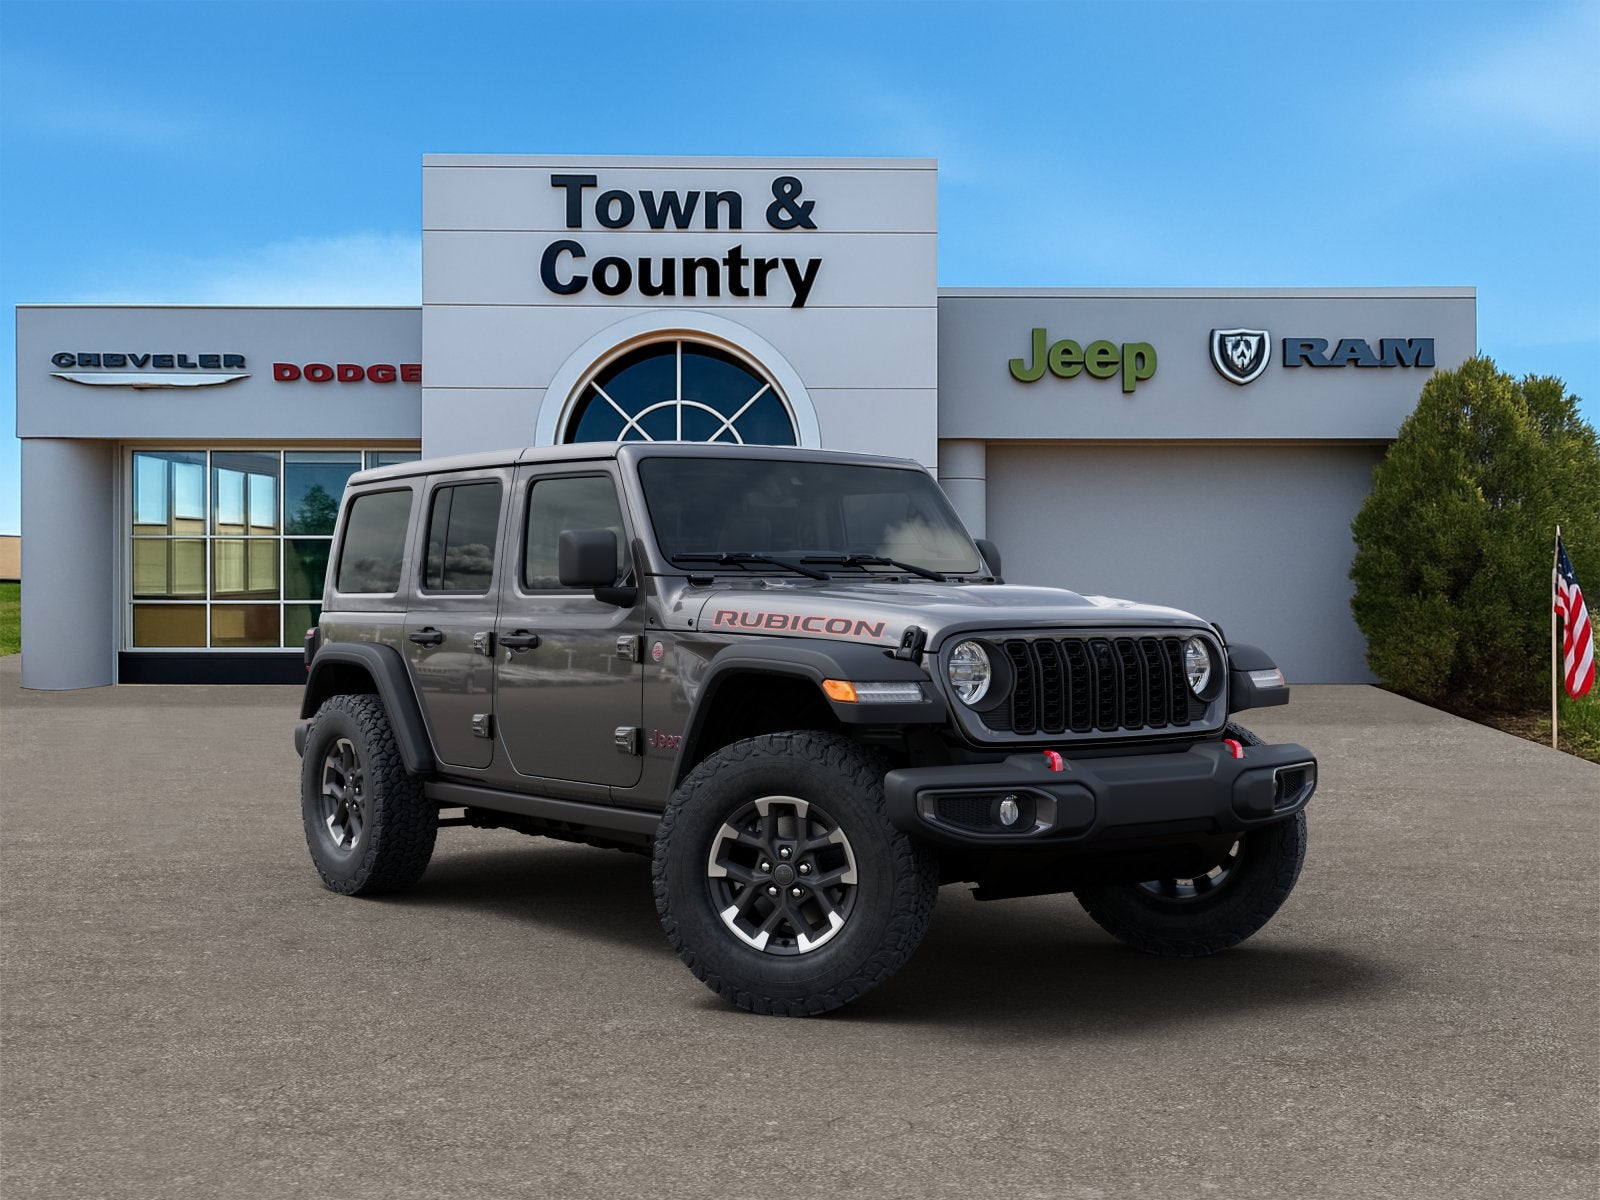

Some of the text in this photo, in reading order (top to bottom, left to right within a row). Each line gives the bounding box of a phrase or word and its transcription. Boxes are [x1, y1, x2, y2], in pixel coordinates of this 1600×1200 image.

[550, 173, 818, 230] Town &
[540, 239, 823, 308] Country
[272, 362, 422, 384] DODGE
[1009, 327, 1158, 394] Jeep
[1282, 336, 1436, 368] RAM
[712, 609, 887, 639] RUBICON
